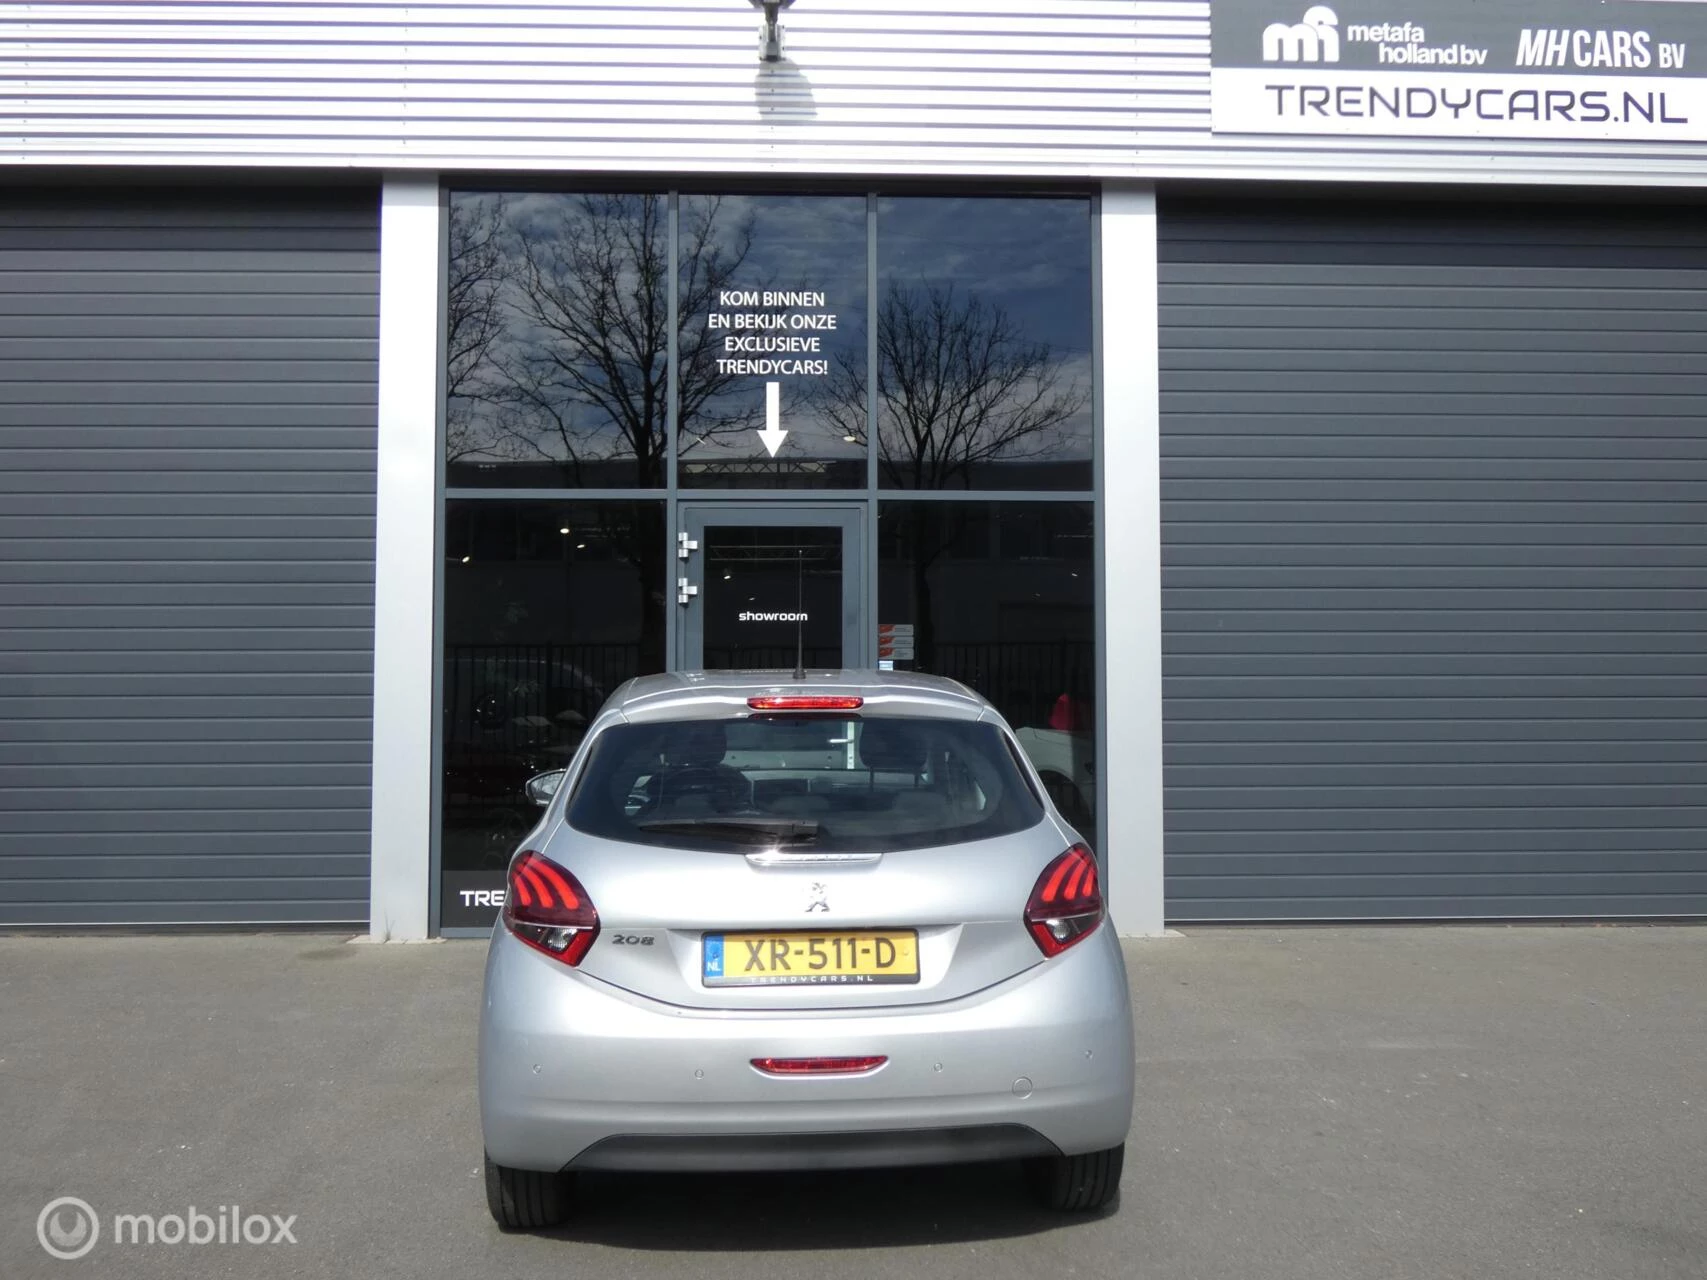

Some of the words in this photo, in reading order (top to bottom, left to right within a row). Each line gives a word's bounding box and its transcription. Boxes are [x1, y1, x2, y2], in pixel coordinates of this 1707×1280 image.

[1347, 22, 1425, 43] metafa
[1658, 43, 1685, 69] BV
[1265, 84, 1688, 124] TRENDYCARS.NL
[720, 291, 759, 306] KOM
[763, 292, 825, 307] BINNEN
[708, 314, 730, 328] EN
[735, 314, 787, 329] BEKIJK
[790, 315, 837, 330] ONZE
[725, 337, 820, 352] EXCLUSIEVE
[716, 359, 828, 375] TRENDYCARS!
[738, 611, 808, 621] showroom
[612, 934, 654, 946] 208
[744, 937, 896, 971] XR-511-D
[707, 962, 721, 971] NL
